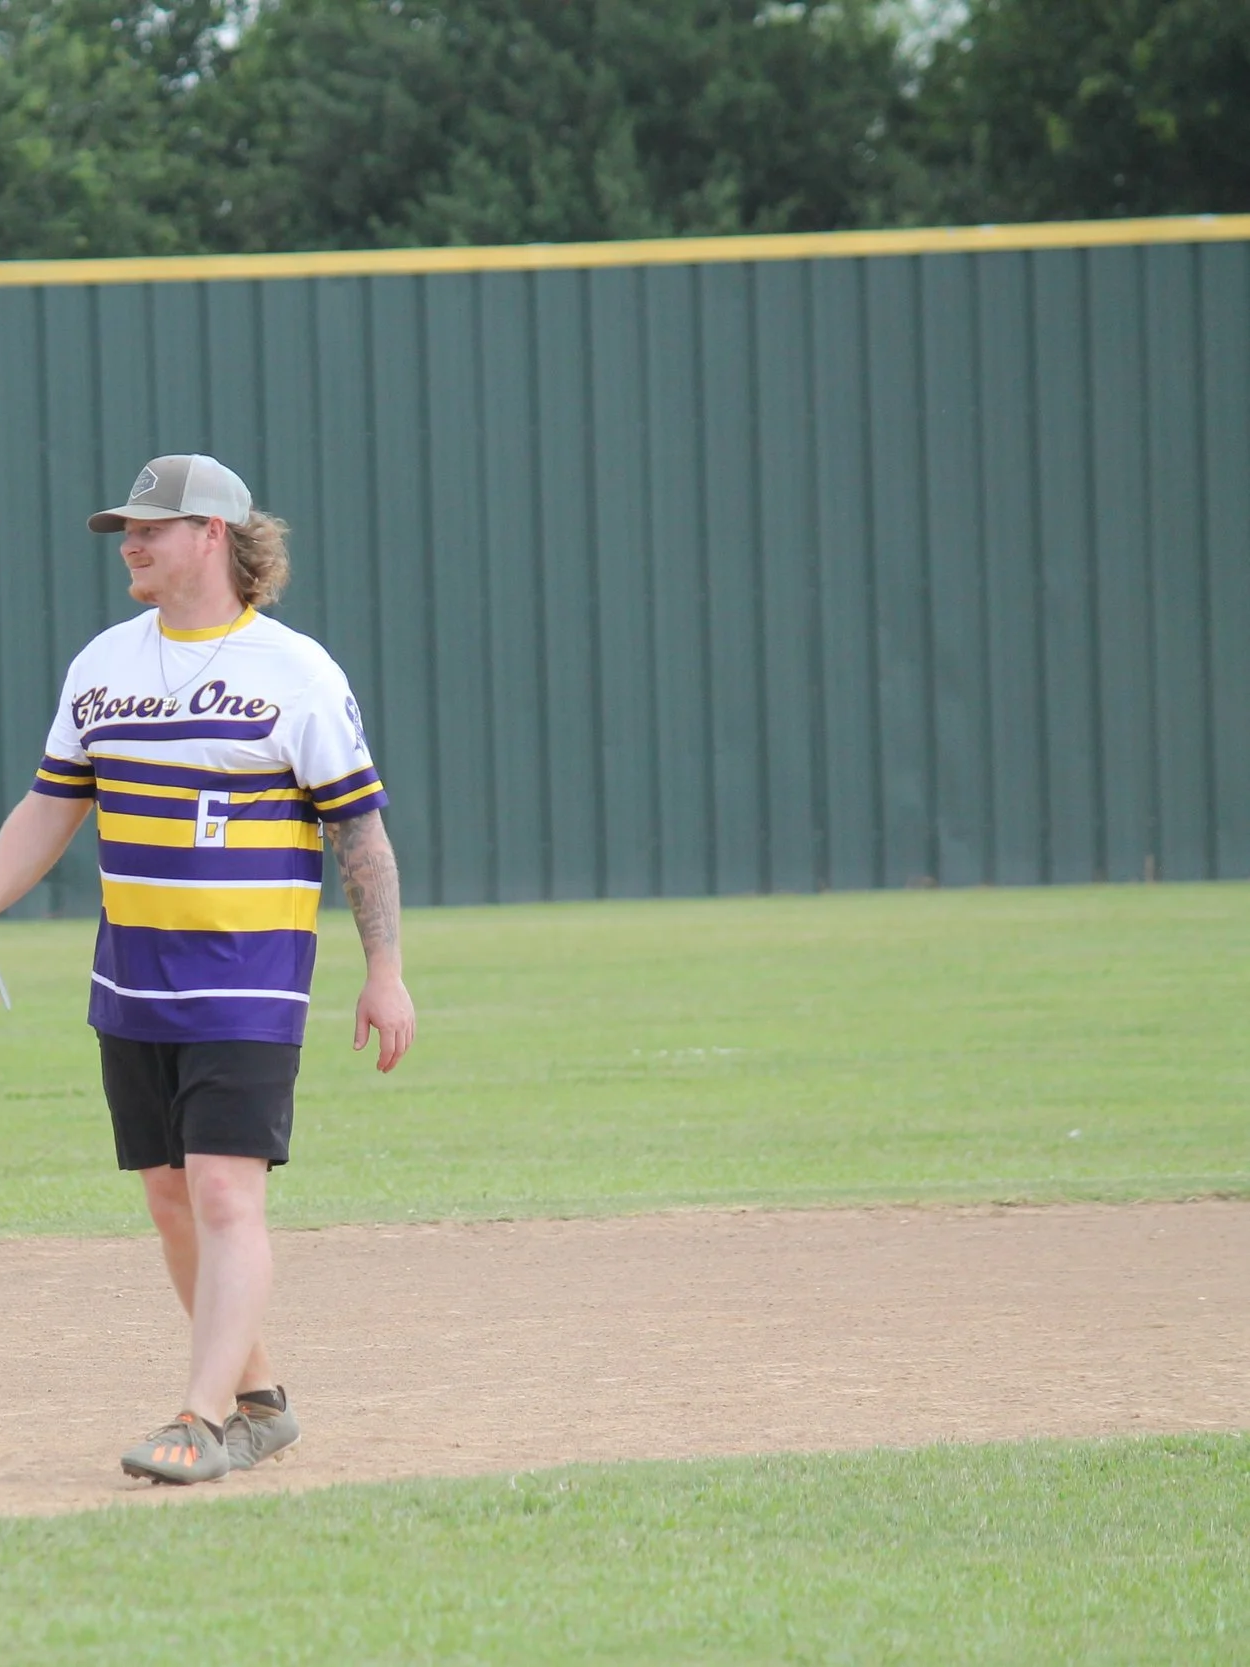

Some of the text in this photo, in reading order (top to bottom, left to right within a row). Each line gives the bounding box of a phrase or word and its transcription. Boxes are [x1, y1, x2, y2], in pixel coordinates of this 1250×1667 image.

[71, 679, 279, 729] Chosen One
[194, 789, 230, 848] 6
